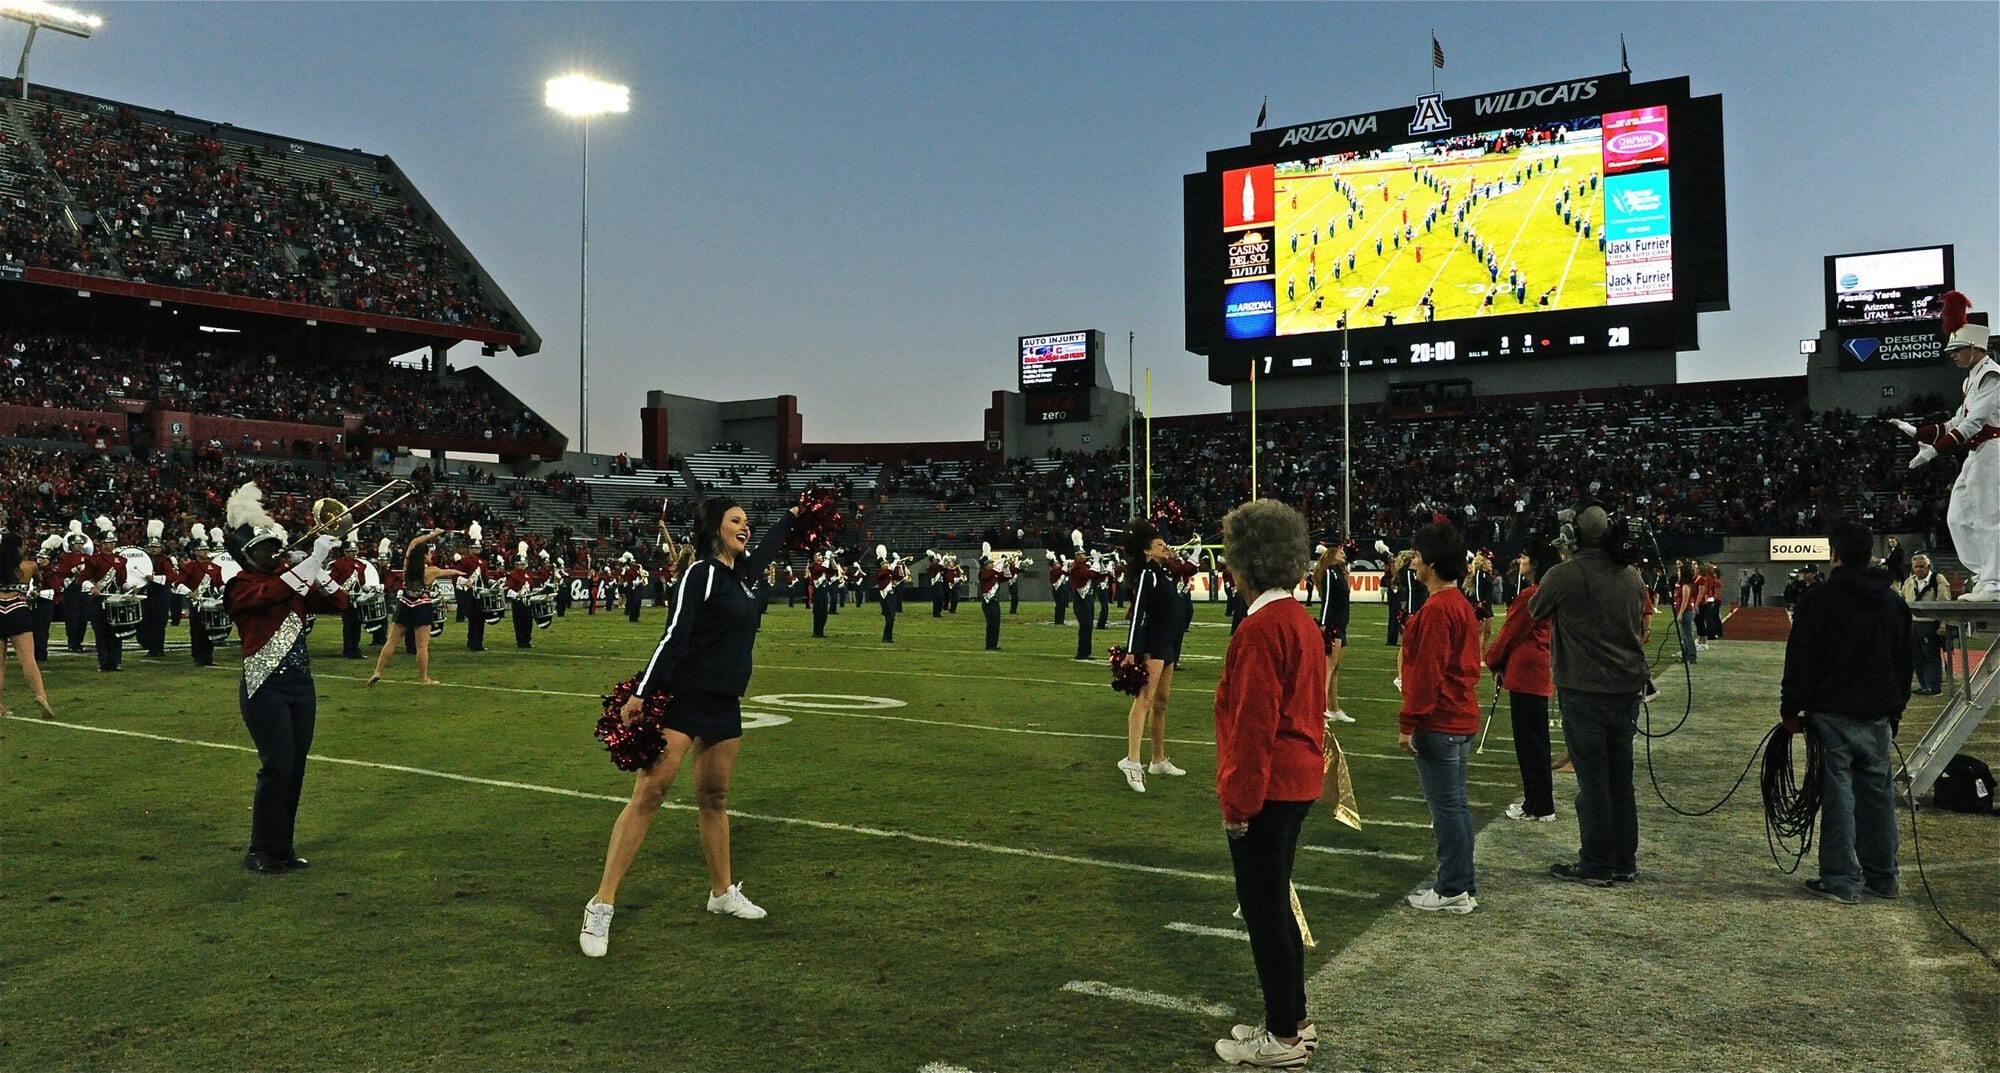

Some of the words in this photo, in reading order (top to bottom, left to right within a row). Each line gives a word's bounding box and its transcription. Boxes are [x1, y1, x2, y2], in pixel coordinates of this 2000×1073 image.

[1474, 80, 1599, 116] WILDCATS
[1409, 91, 1453, 136] A
[1279, 115, 1377, 148] ARIZONA
[1228, 243, 1269, 257] CASINO
[1608, 241, 1632, 255] Jack
[1635, 238, 1670, 252] Furrier
[1229, 255, 1251, 267] DEL
[1250, 253, 1270, 265] SOL
[1231, 265, 1267, 278] 11/11/11
[1608, 273, 1633, 288] Jack
[1636, 270, 1671, 284] Furrier
[1838, 293, 1875, 302] Passing
[1875, 290, 1902, 300] Yards
[1864, 302, 1895, 312] Arizona
[1864, 311, 1889, 321] UTAH
[1911, 308, 1928, 318] 117
[1024, 338, 1047, 346] AUTO
[1049, 334, 1085, 344] INJURY?
[1885, 333, 1936, 344] DESERT
[1410, 341, 1456, 363] 20:00
[1879, 341, 1942, 353] DIAMOND
[1881, 350, 1940, 361] CASINOS
[1263, 356, 1272, 374] 7
[1883, 387, 1894, 396] 14
[1042, 411, 1067, 420] zero
[1424, 405, 1434, 413] 12
[1772, 545, 1812, 554] SOLON
